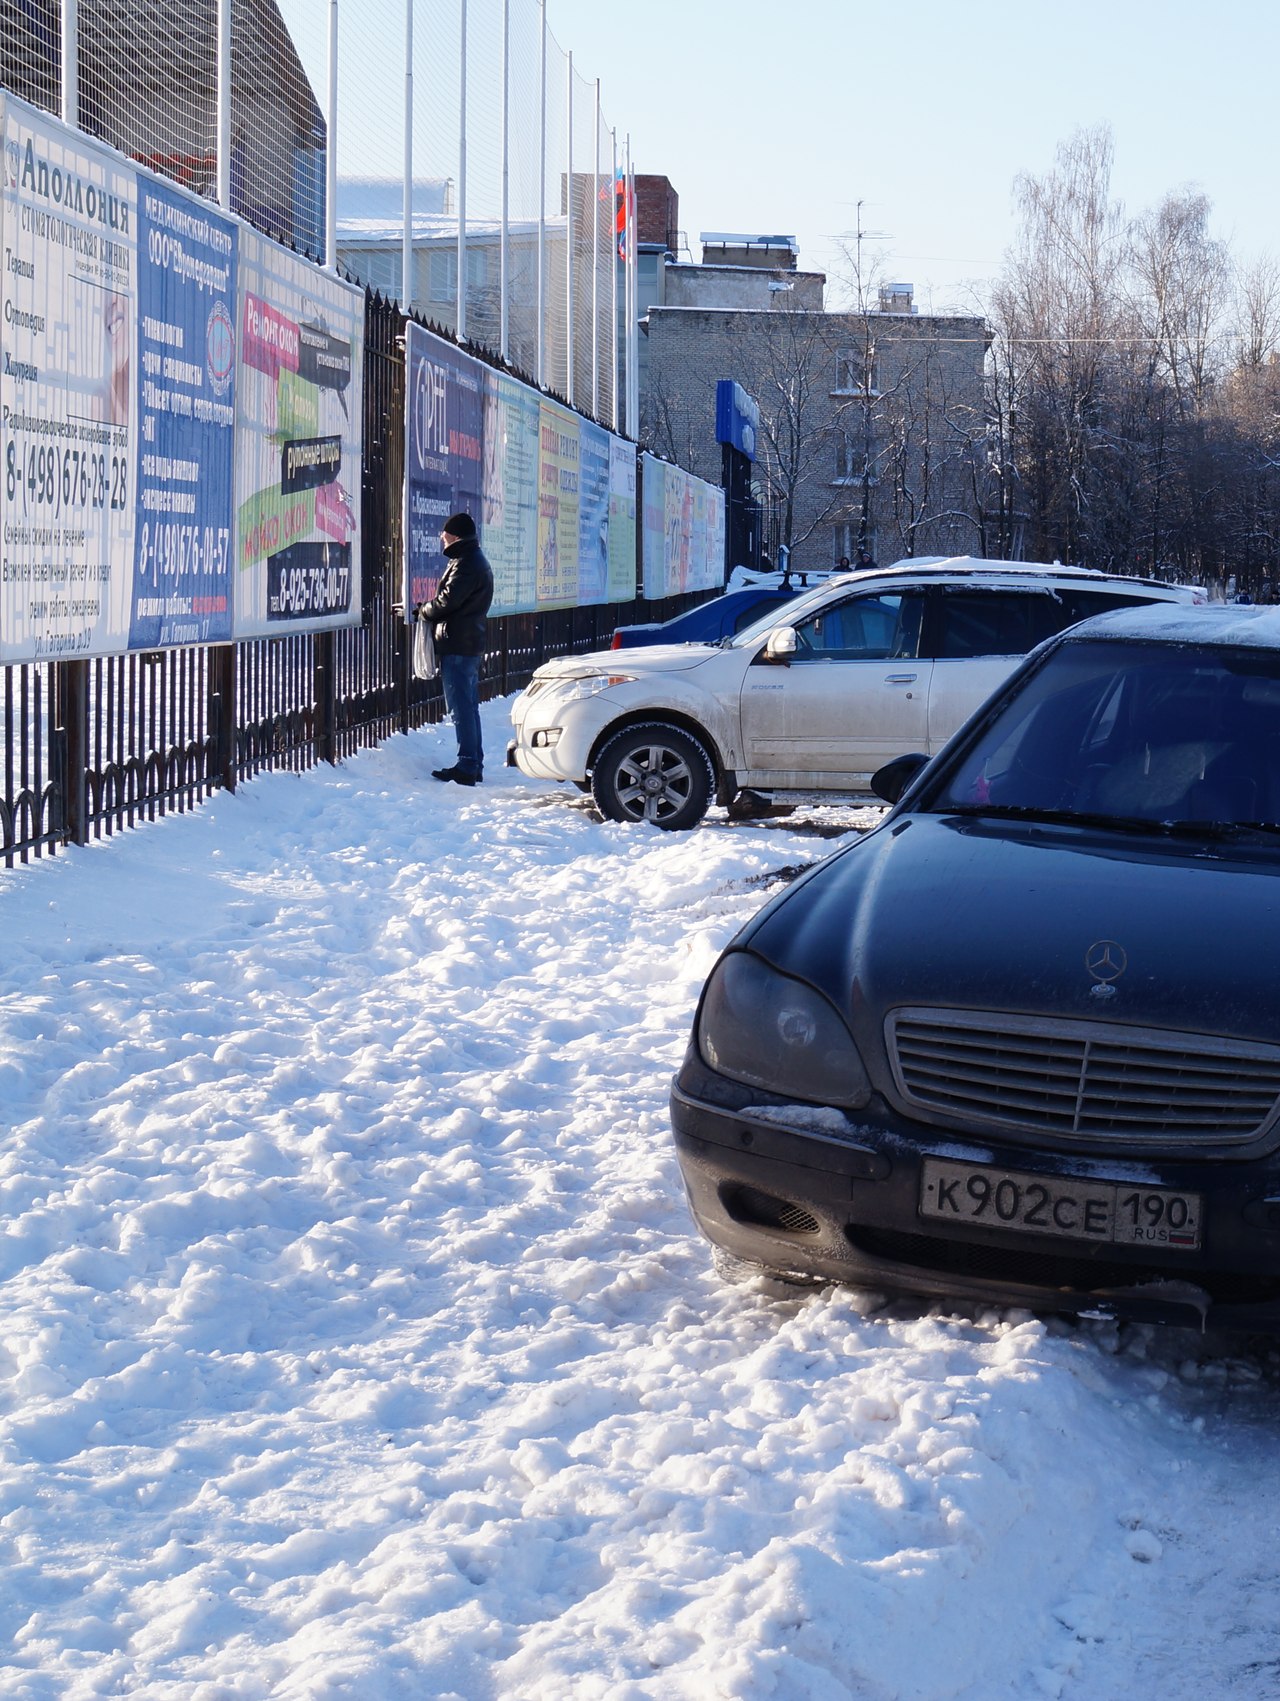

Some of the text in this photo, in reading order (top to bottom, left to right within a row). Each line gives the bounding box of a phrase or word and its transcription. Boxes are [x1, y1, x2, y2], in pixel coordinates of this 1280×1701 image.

[22, 137, 129, 234] Аполлония
[21, 203, 98, 260] стоматологическая
[145, 194, 233, 257] МЕДИЦИНСКИЙ ЦЕНТР
[6, 247, 35, 281] Терапия
[5, 298, 46, 336] Ортопедия
[247, 297, 278, 347] Ремонт
[279, 324, 299, 357] окон
[5, 351, 38, 385] Хирургия
[7, 439, 127, 520] 8-(498)676-28-28
[287, 441, 340, 480] рулонные шторы
[137, 597, 165, 621] режим
[936, 1174, 1189, 1235] К902СЕ 190
[1134, 1227, 1168, 1242] RUS
